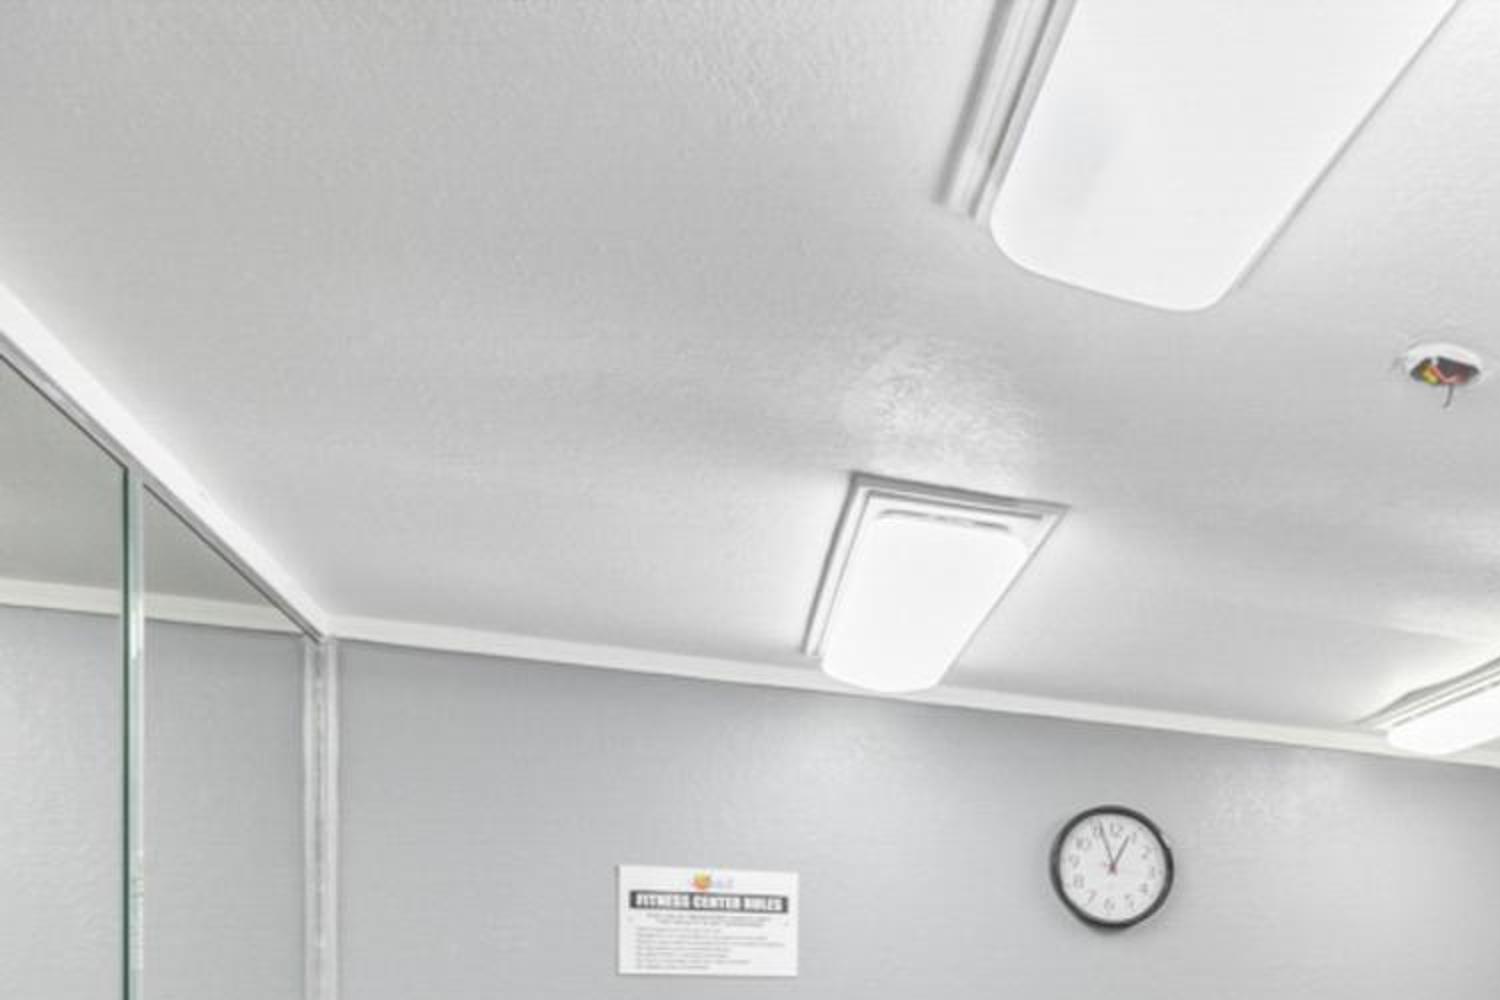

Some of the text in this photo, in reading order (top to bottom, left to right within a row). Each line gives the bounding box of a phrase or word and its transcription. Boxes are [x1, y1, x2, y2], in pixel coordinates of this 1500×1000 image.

[636, 892, 783, 912] FITNESS CENTER RULES
